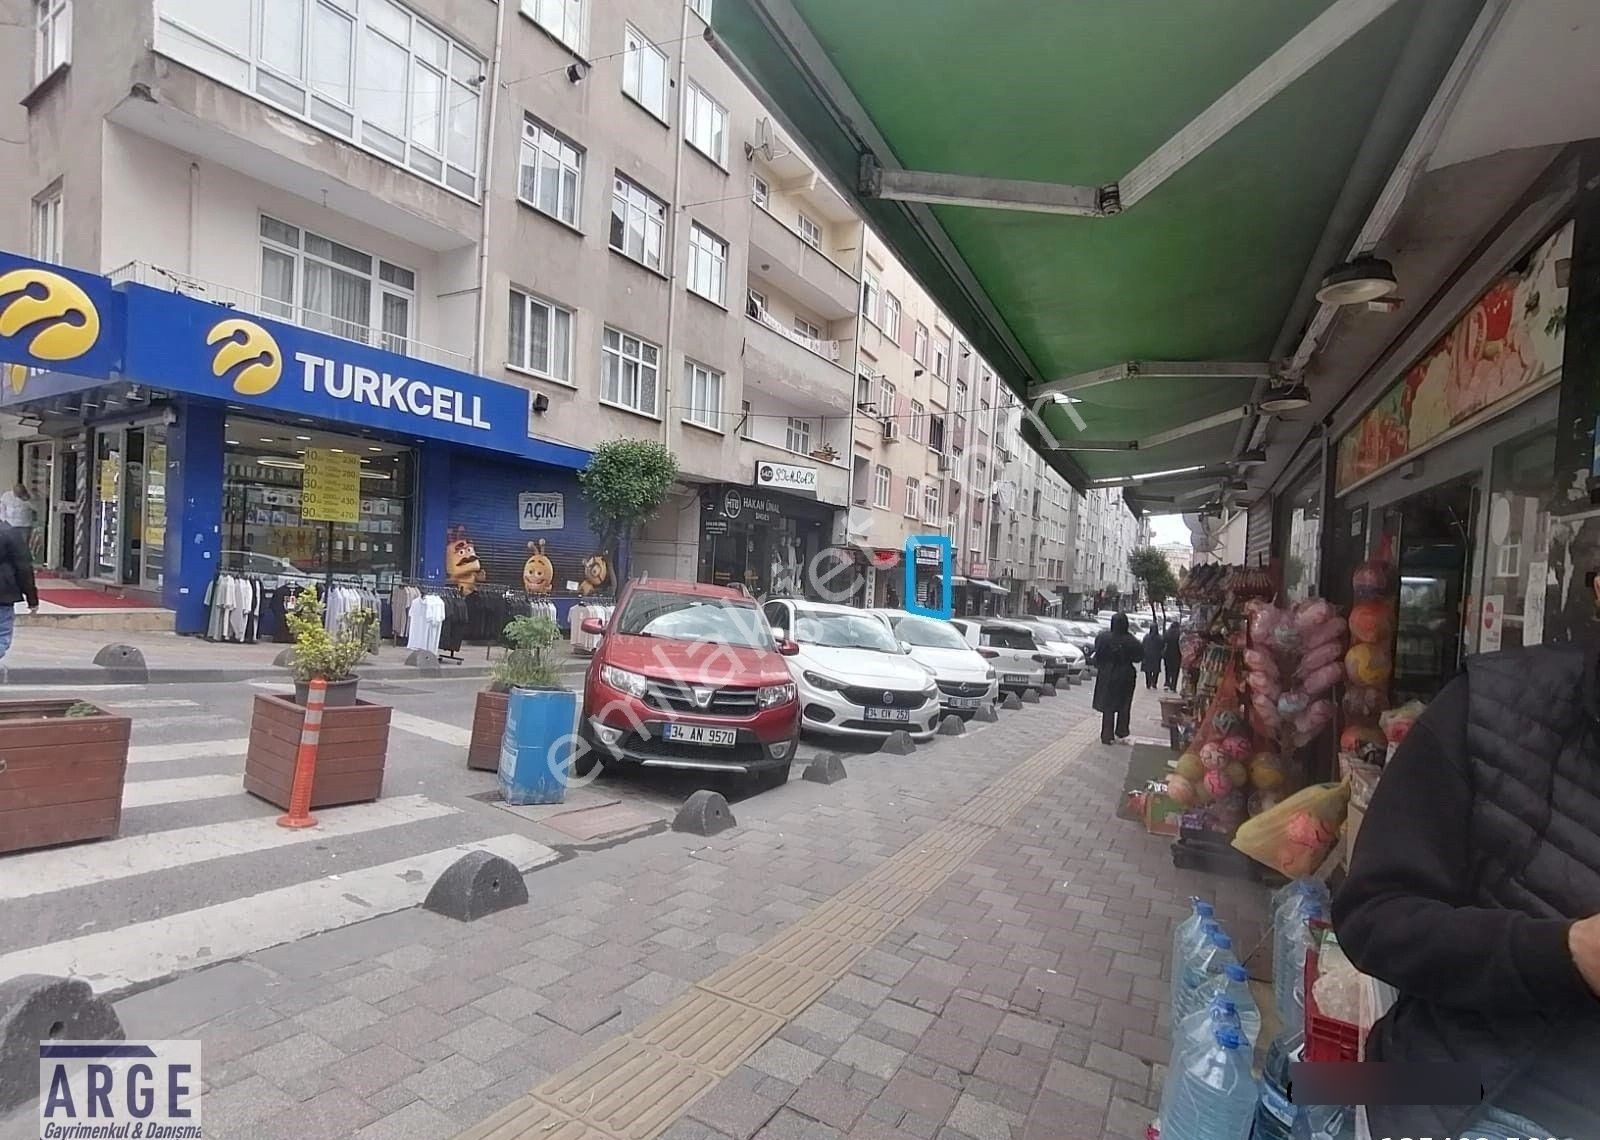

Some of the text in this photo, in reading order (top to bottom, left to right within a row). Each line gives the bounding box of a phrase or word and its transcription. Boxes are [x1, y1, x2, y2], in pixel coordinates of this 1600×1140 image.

[295, 352, 491, 430] TURKCELL
[304, 464, 318, 475] 20
[303, 479, 317, 489] 30
[303, 492, 316, 503] 60
[743, 497, 765, 511] HAKAN
[302, 507, 316, 518] 90
[524, 502, 557, 520] AÇIK!
[672, 726, 734, 744] 34 AN 9570
